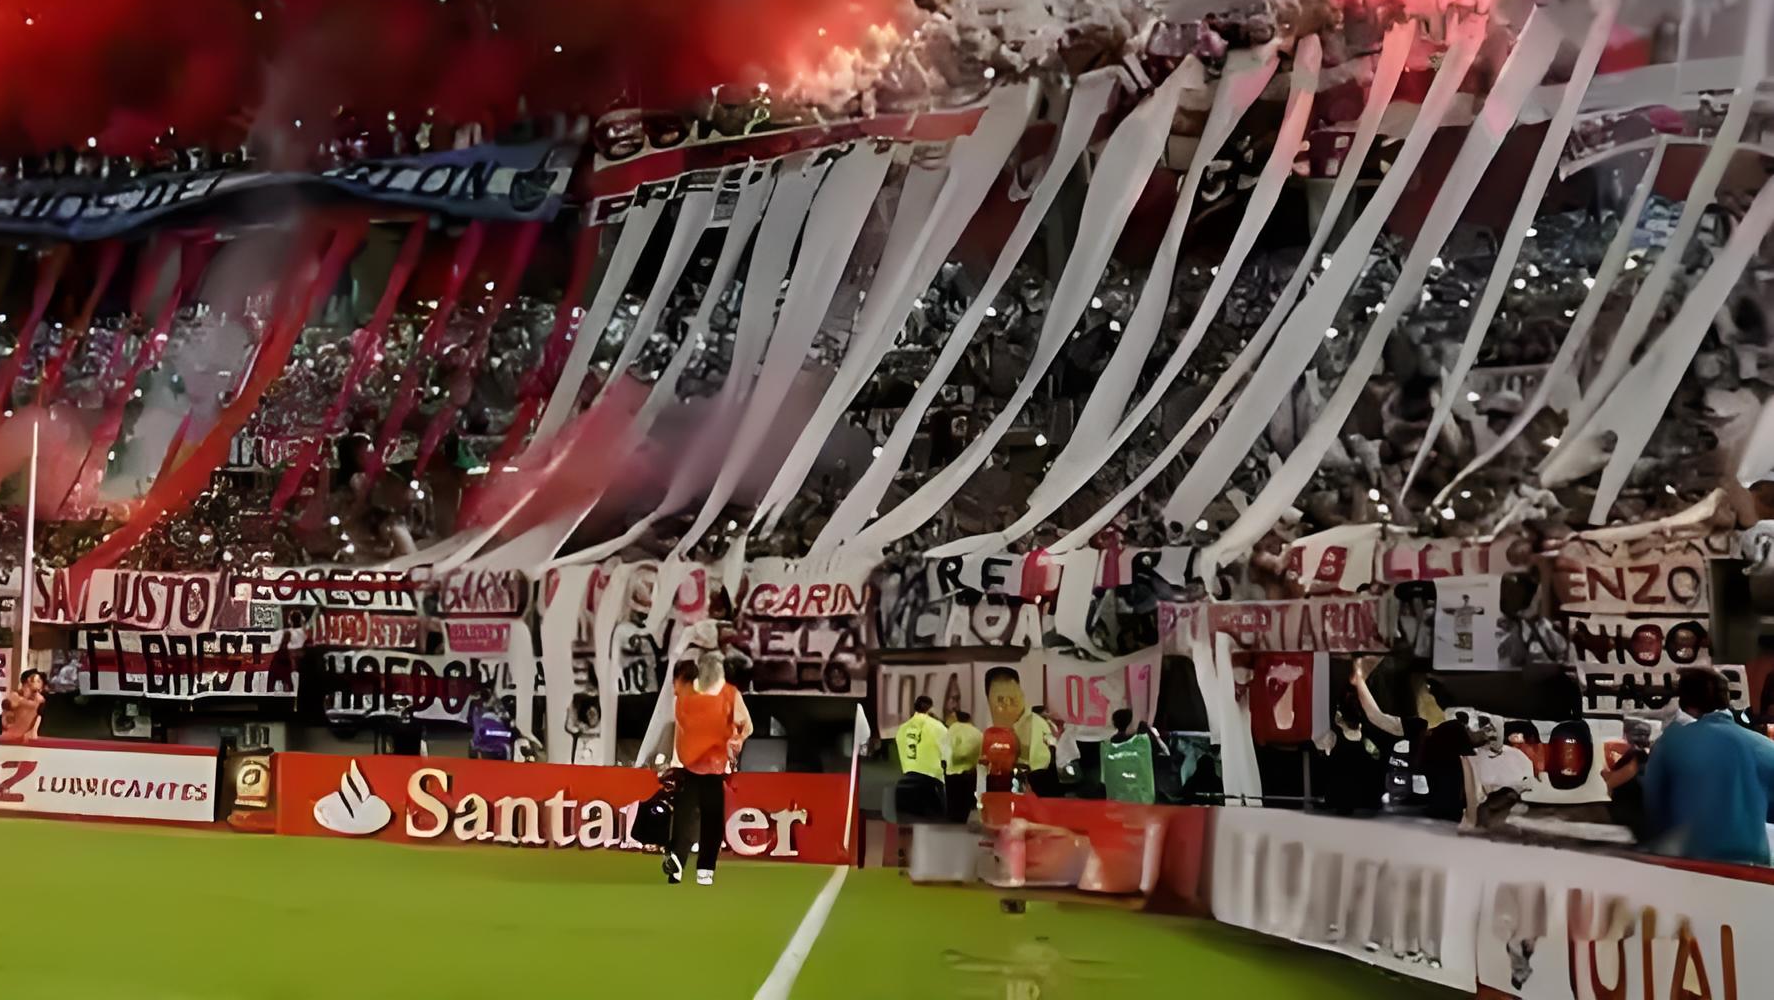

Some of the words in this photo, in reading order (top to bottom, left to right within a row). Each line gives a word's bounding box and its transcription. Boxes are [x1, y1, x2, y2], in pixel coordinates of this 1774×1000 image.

[99, 571, 210, 629] JUSTO
[1557, 563, 1701, 607] ENZO
[405, 767, 808, 857] Santaer
